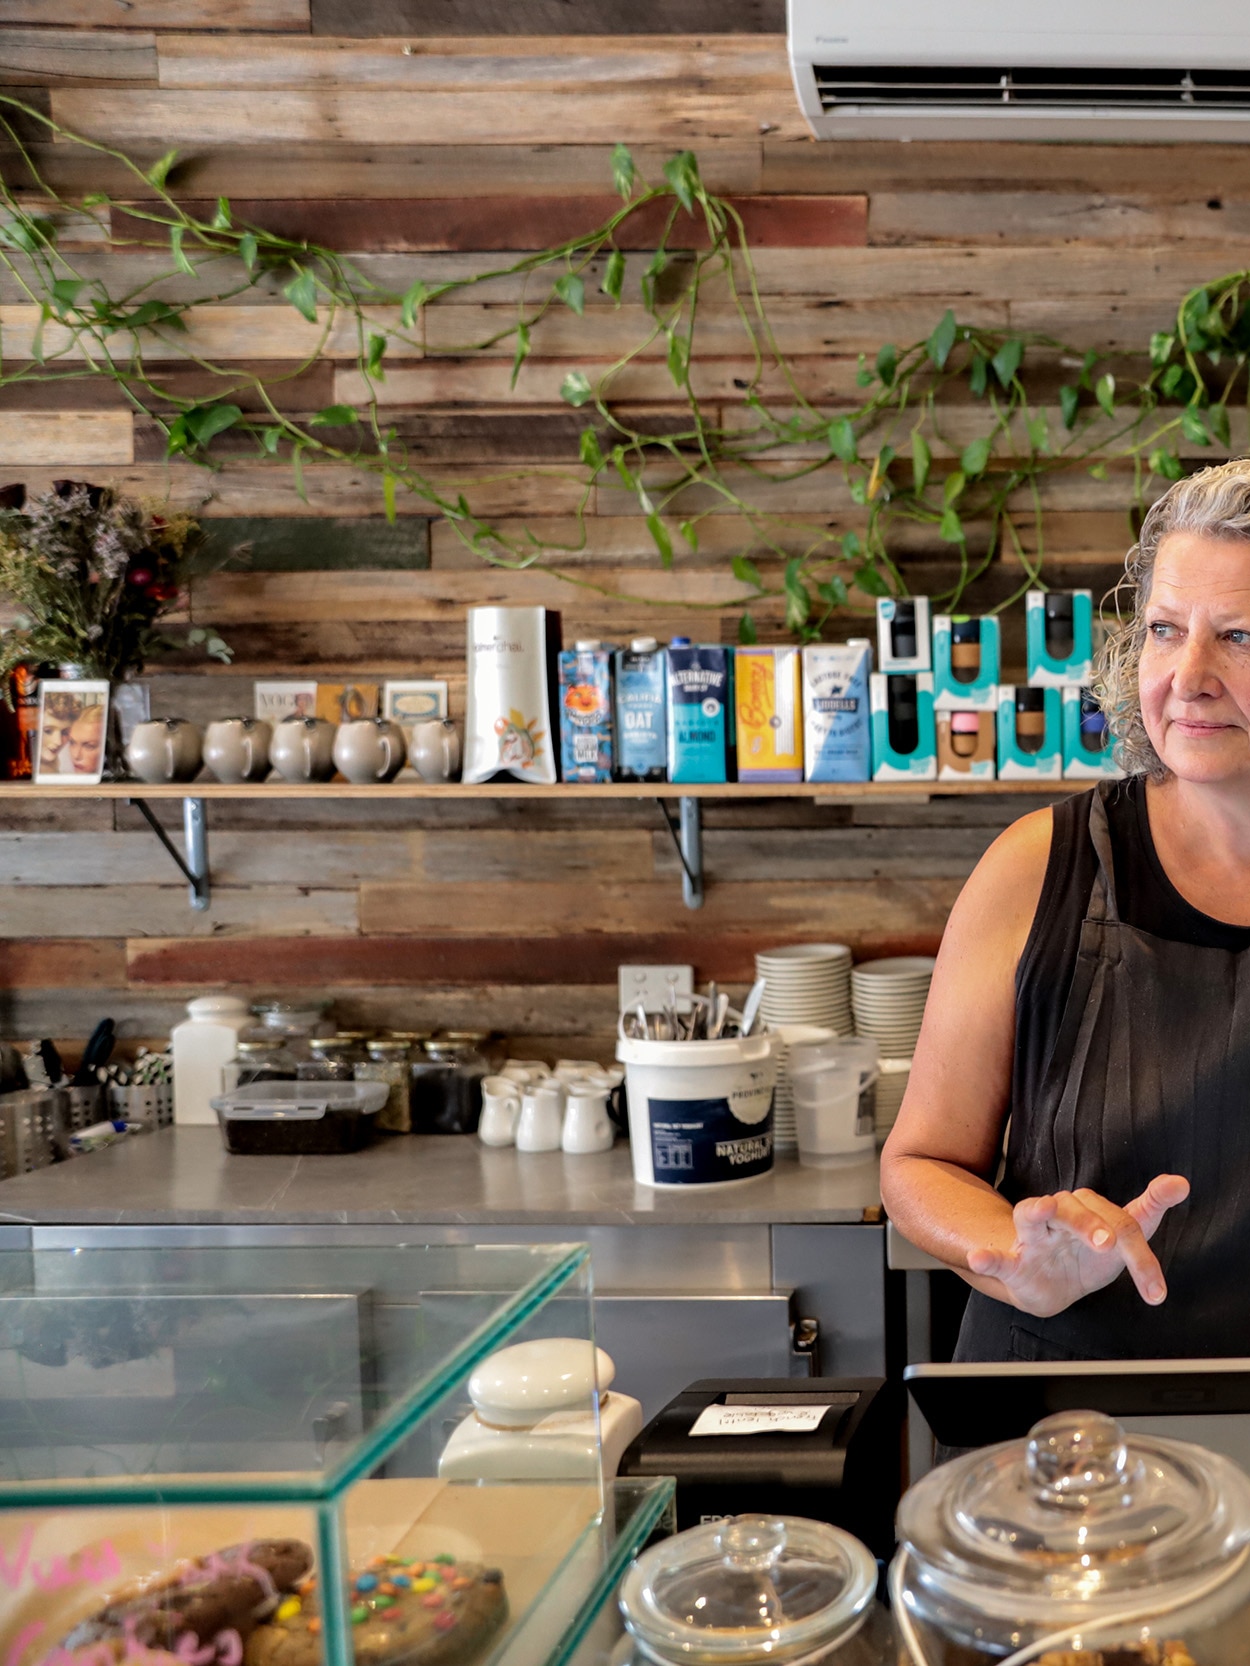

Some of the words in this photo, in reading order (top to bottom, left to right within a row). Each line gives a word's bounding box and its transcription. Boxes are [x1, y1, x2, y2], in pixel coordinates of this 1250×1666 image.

[670, 669, 723, 688] ALTERNATIVE
[624, 711, 654, 729] OAT
[679, 730, 716, 743] ALMOND
